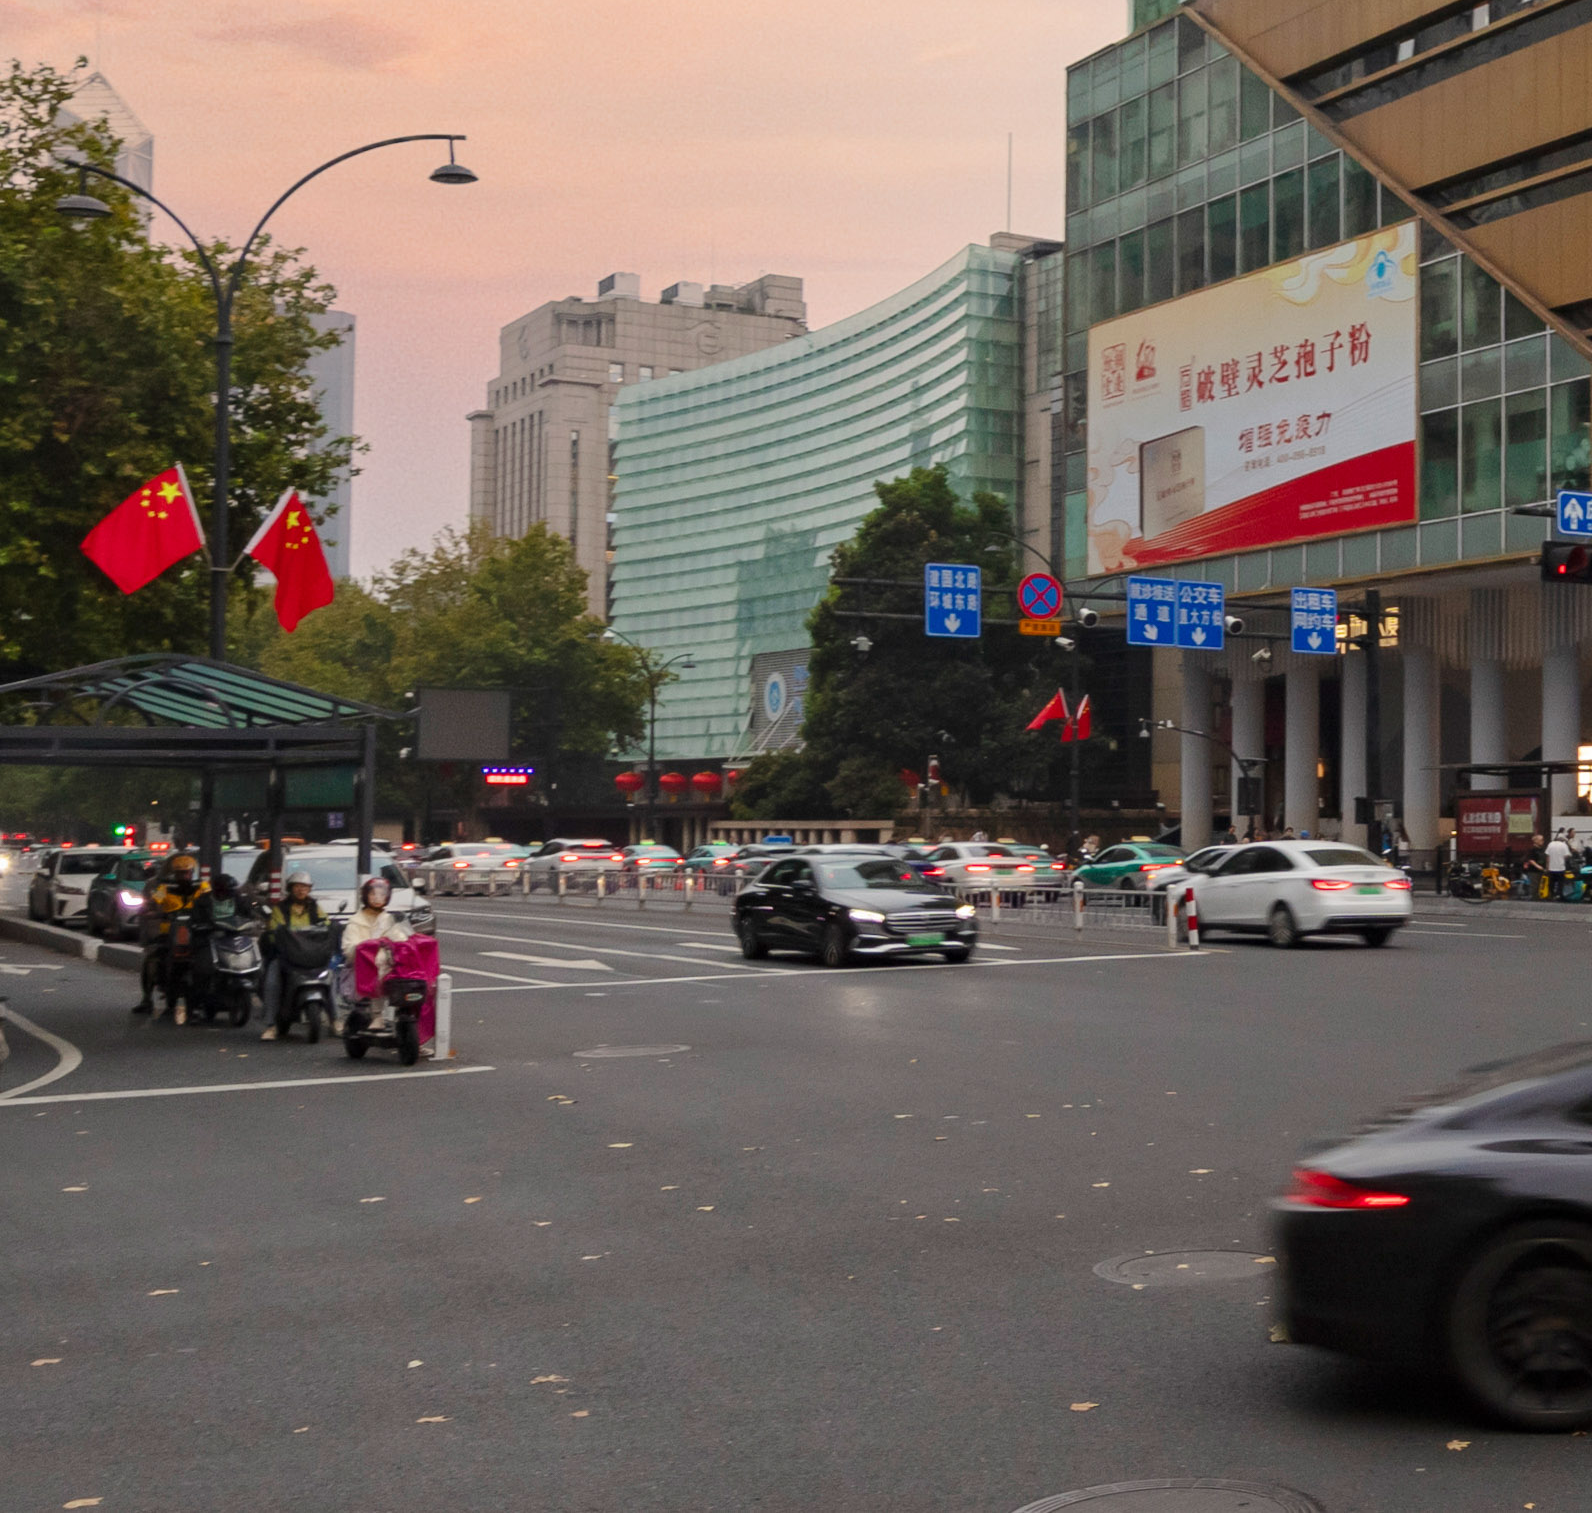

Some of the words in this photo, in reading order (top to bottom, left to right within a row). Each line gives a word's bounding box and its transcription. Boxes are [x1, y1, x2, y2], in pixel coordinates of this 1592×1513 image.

[1196, 321, 1372, 405] 破壁灵芝孢子粉
[1238, 412, 1333, 453] 增强免疫力
[929, 570, 977, 589] 建国北路
[929, 591, 977, 611] 环城东路
[1179, 586, 1221, 604] 公交车
[1294, 592, 1334, 610] 出租车
[1293, 611, 1334, 630] 网约车
